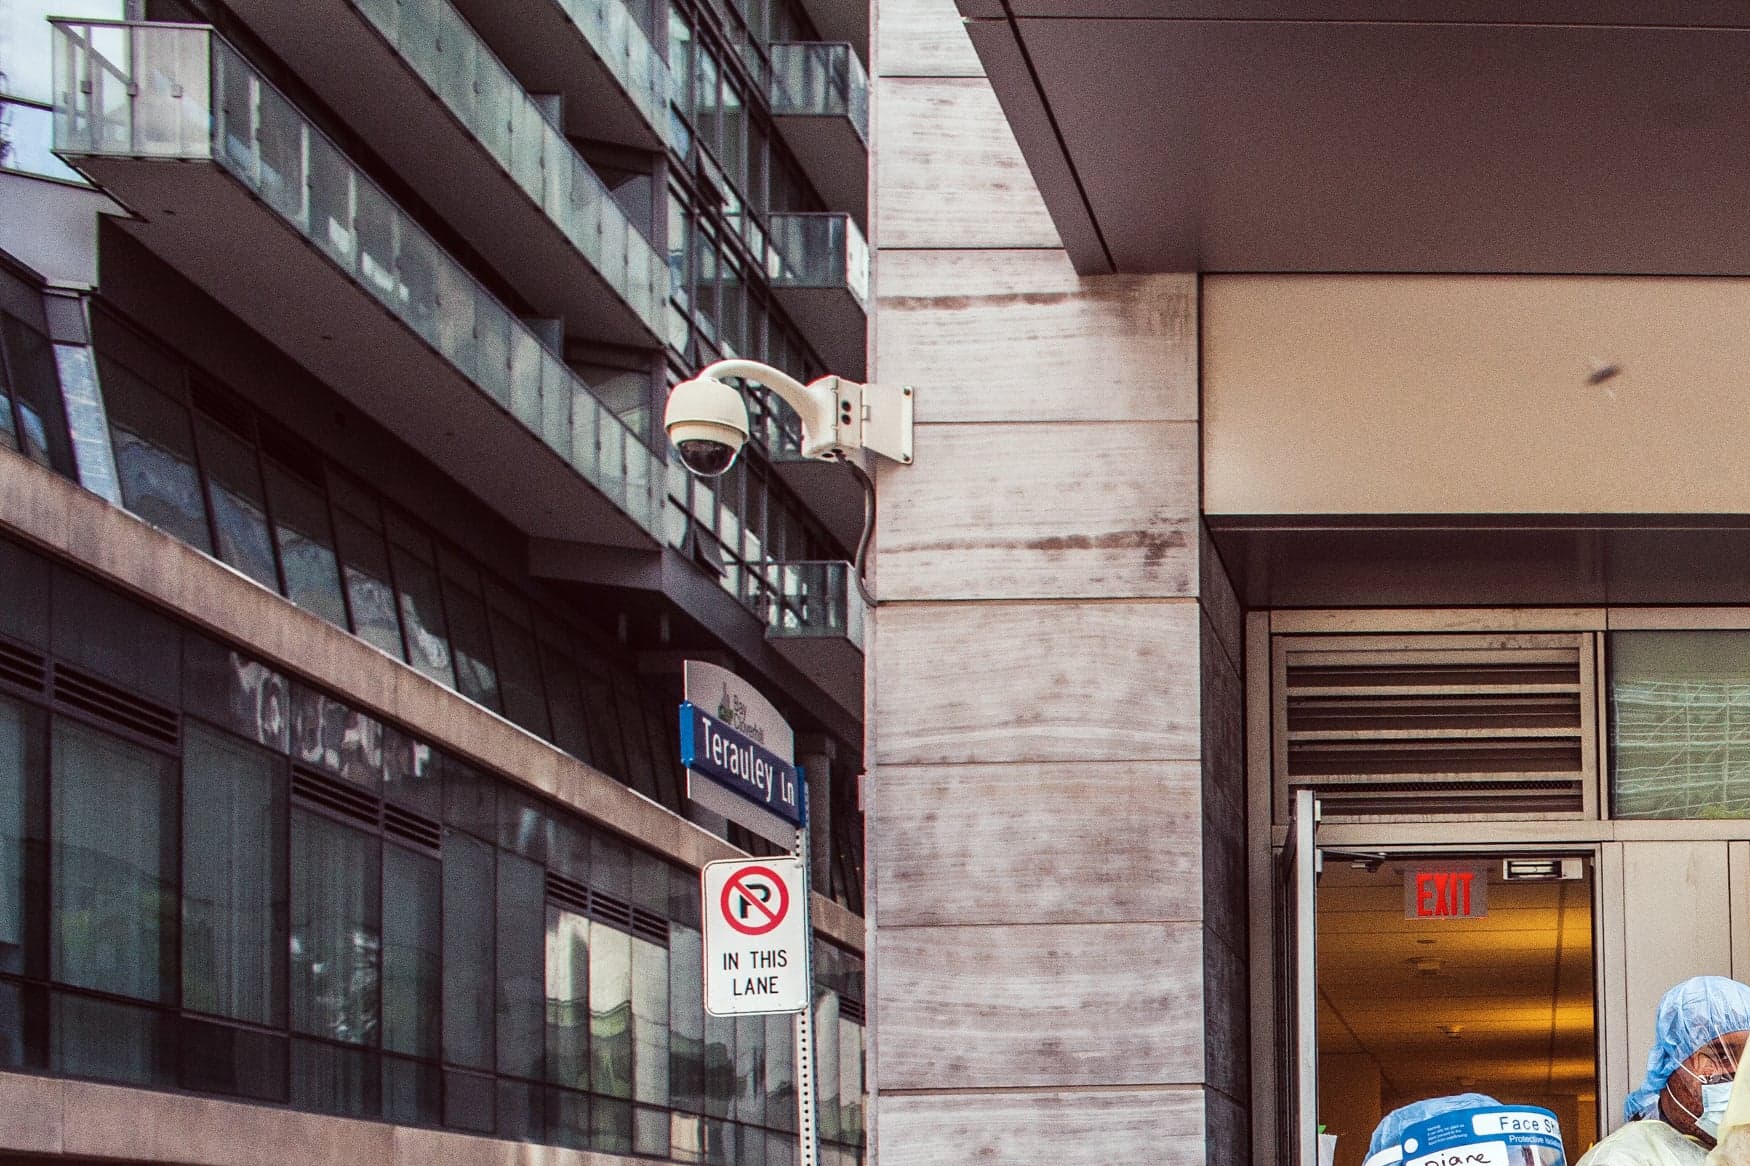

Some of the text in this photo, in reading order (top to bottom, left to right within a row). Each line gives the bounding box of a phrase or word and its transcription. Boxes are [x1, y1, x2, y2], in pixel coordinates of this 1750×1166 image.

[702, 716, 796, 807] Terauley Ln
[1415, 871, 1475, 916] EXIT
[723, 949, 788, 971] IN THIS
[733, 976, 780, 997] LANE
[1499, 1115, 1540, 1132] Face
